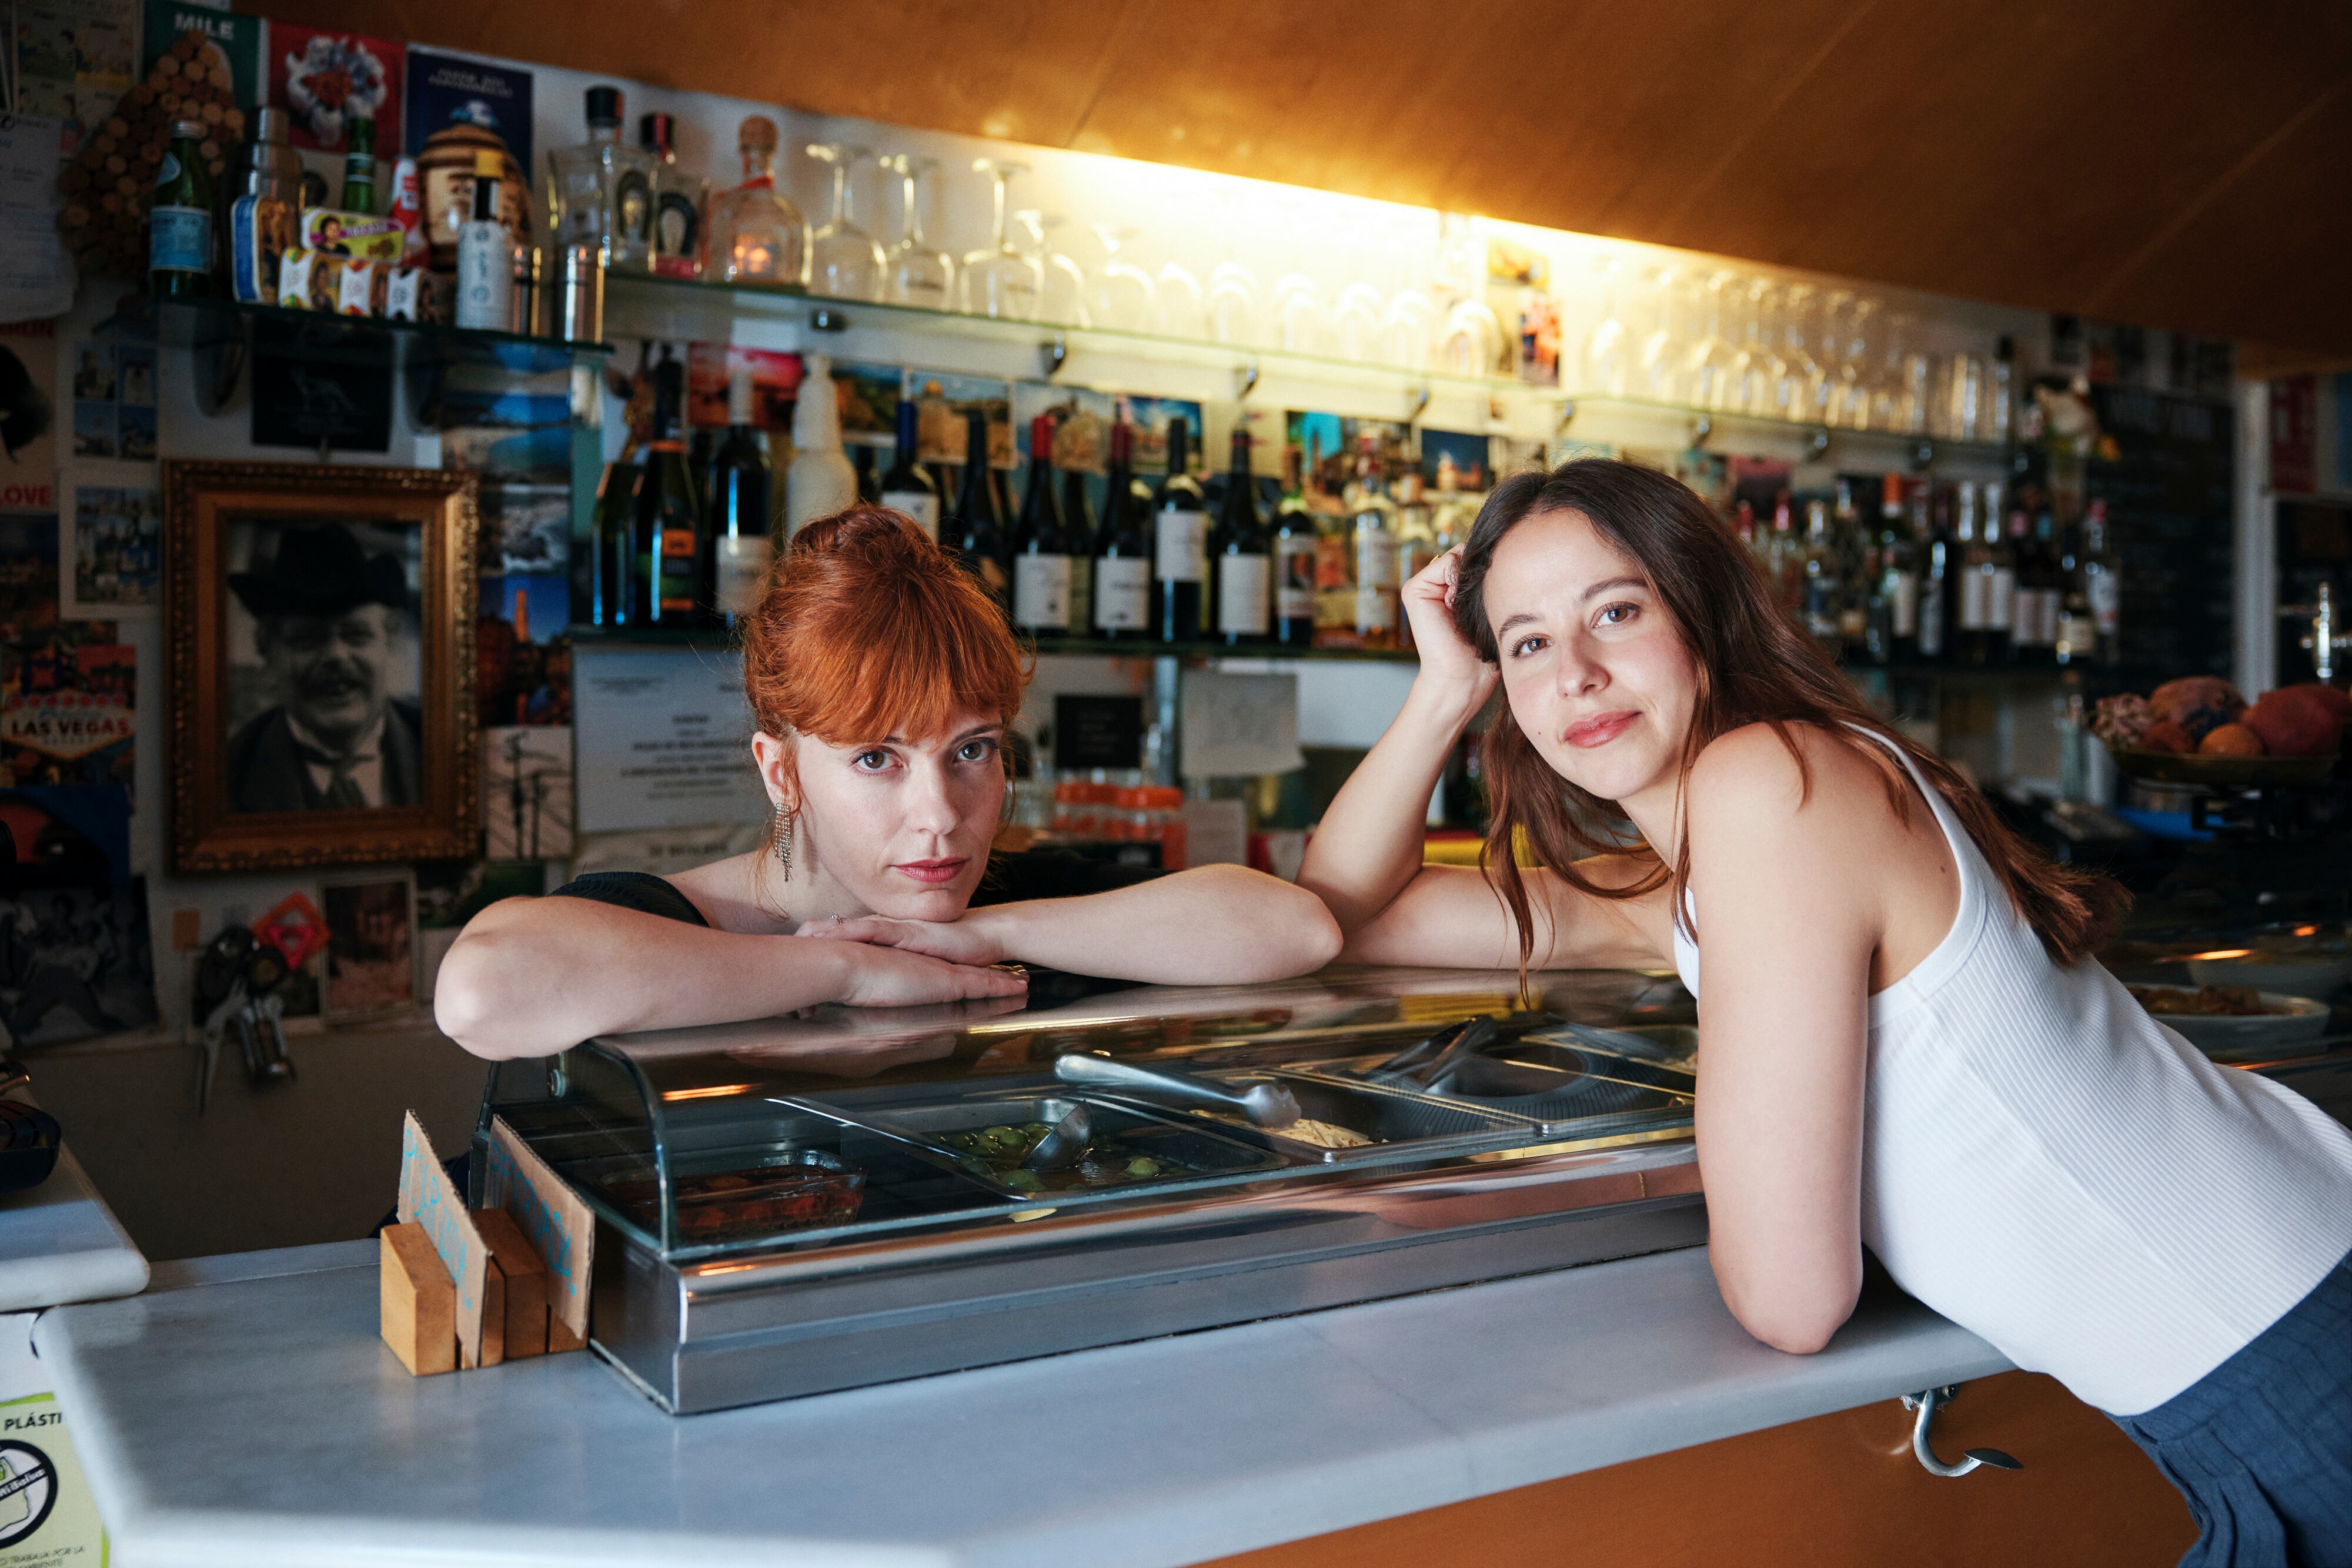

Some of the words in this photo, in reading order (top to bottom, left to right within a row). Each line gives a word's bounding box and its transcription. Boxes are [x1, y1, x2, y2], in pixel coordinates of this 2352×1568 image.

[173, 11, 235, 41] MILE
[11, 719, 49, 735] LAS
[57, 717, 129, 736] VEGAS
